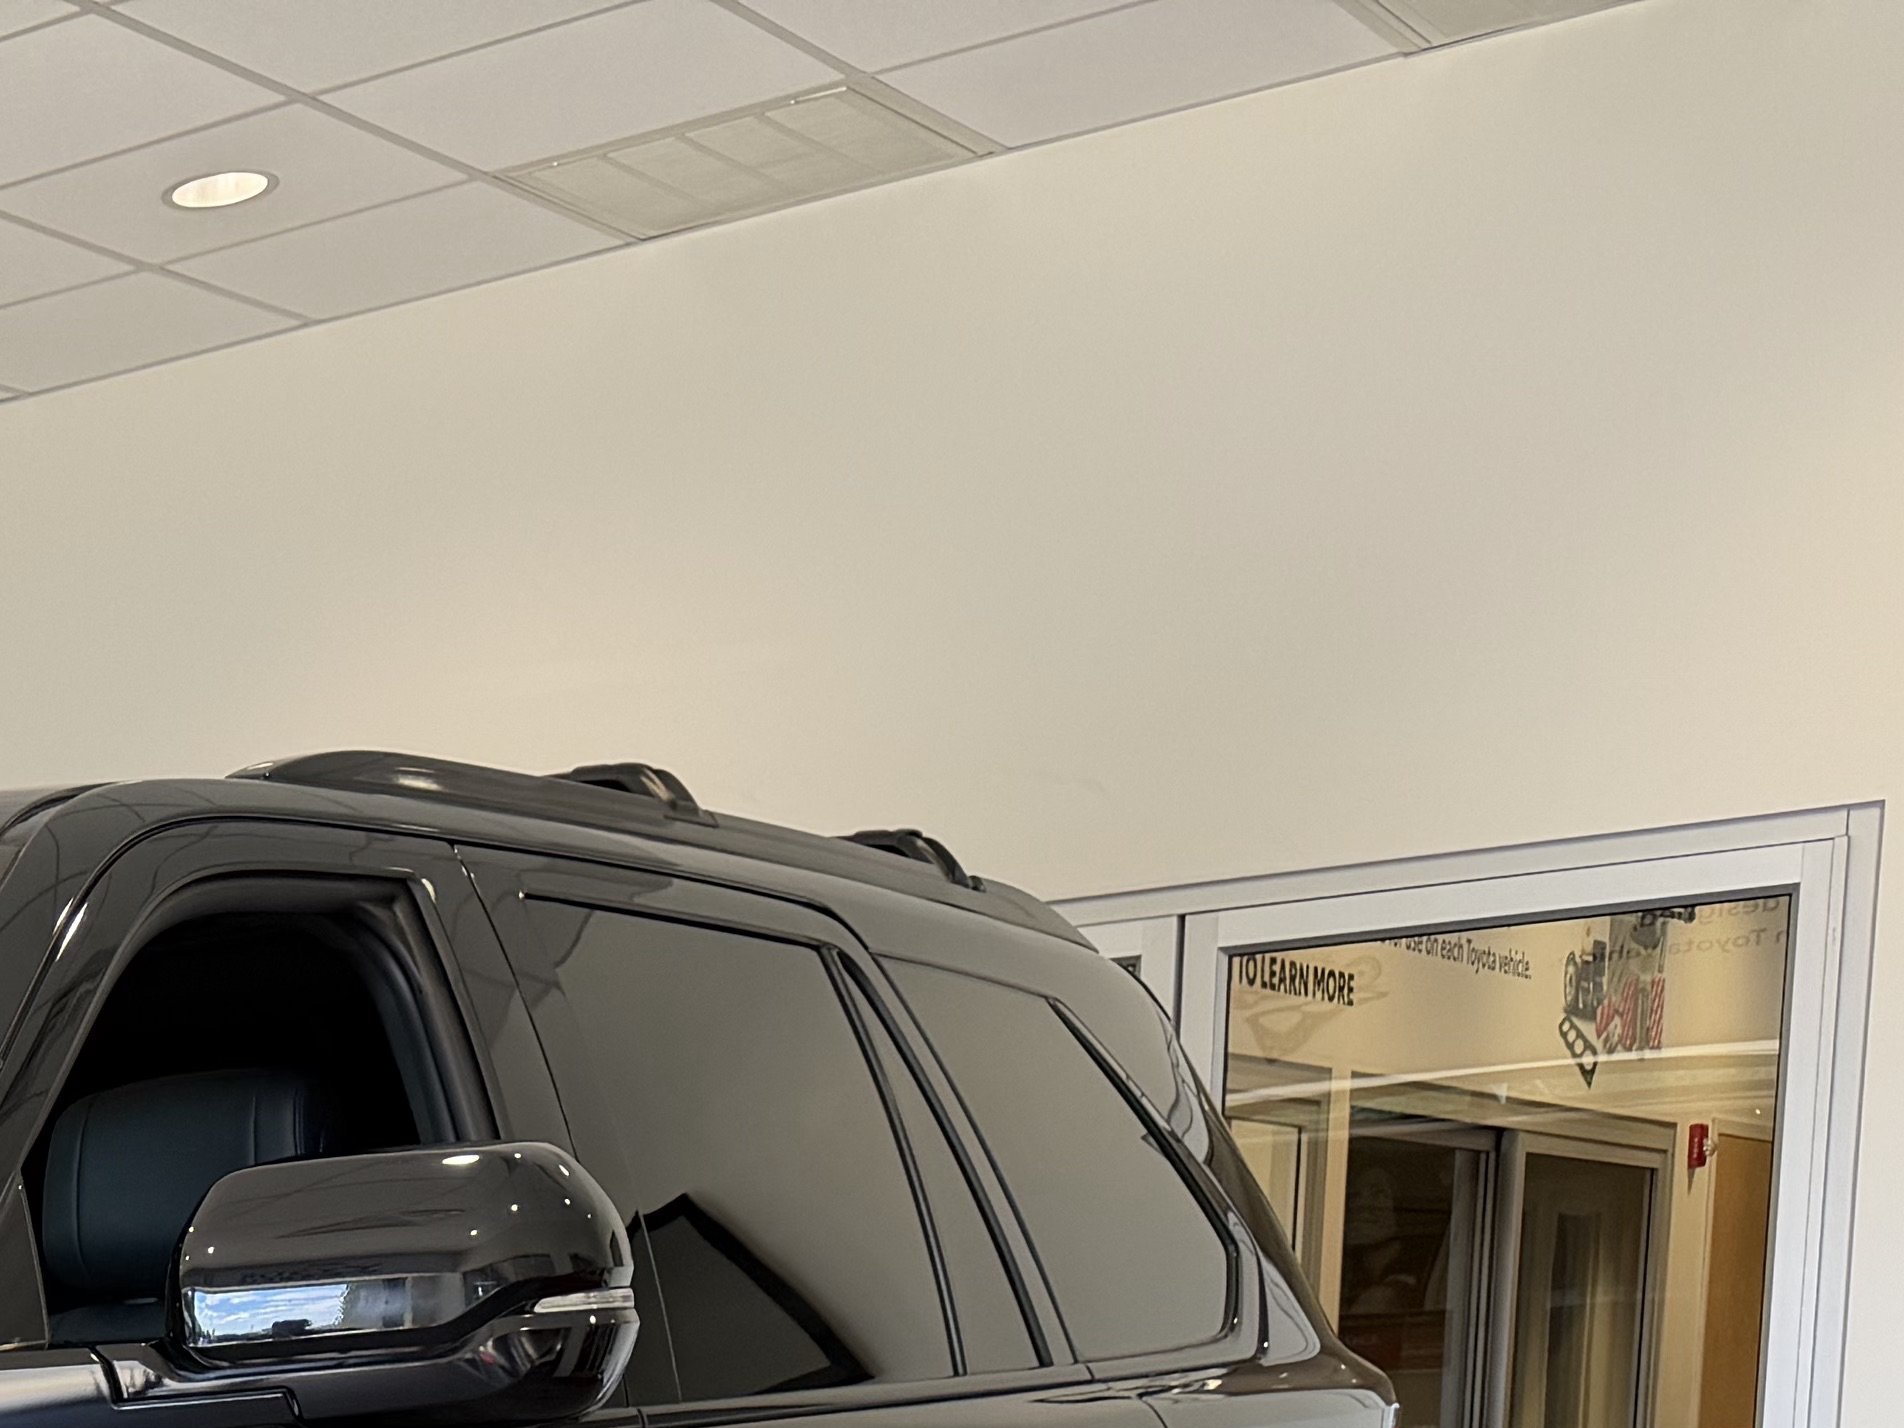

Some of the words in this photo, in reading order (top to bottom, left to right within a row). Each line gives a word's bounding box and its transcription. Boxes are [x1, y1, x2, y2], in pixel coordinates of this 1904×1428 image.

[1260, 955, 1309, 998] LEARN
[1312, 965, 1355, 1006] MORE
[1425, 936, 1439, 957] on
[1441, 936, 1465, 962] each
[1466, 938, 1496, 974] Toyota
[1498, 948, 1532, 979] vehicle.
